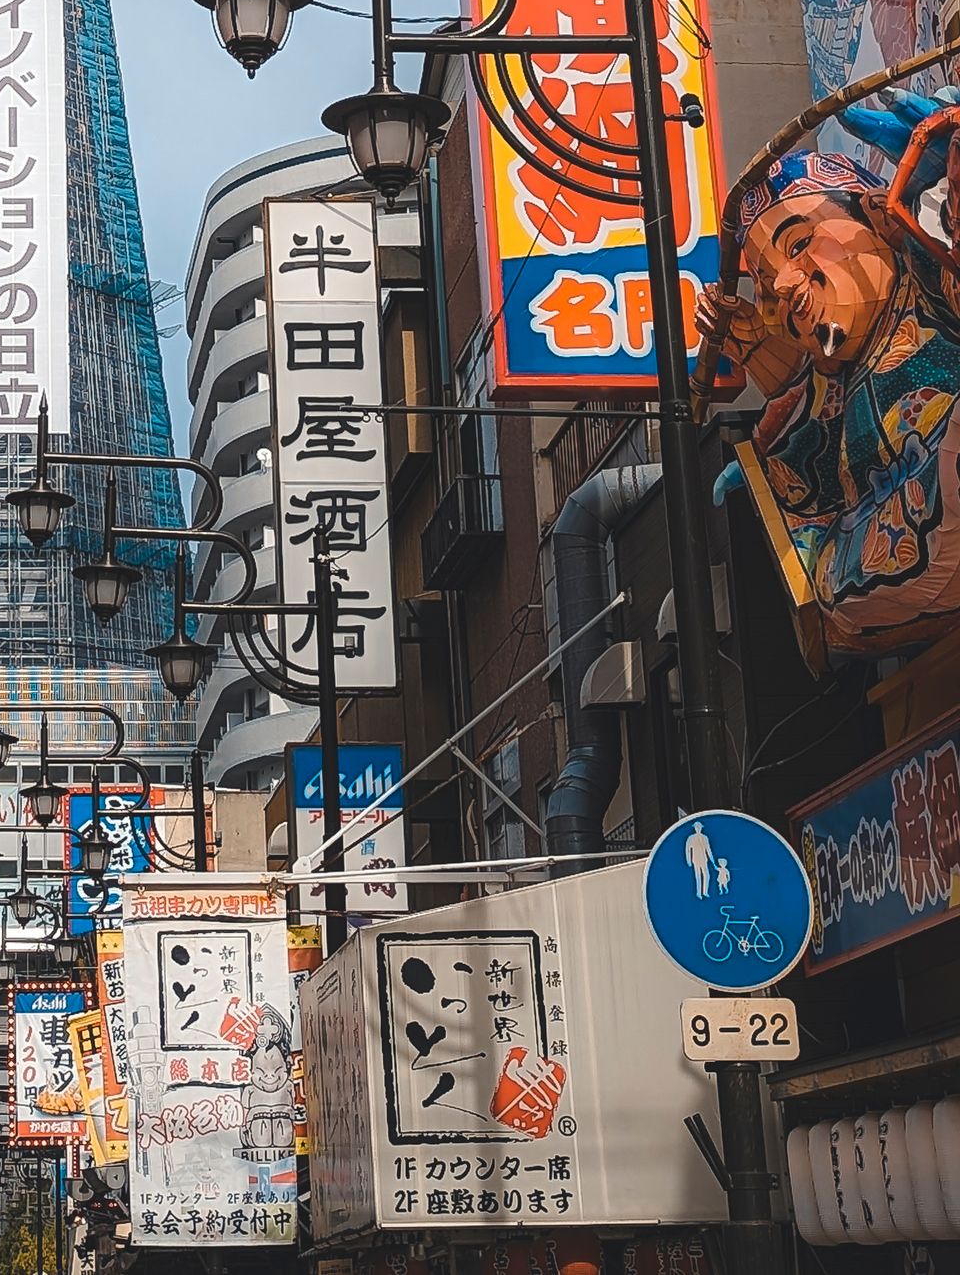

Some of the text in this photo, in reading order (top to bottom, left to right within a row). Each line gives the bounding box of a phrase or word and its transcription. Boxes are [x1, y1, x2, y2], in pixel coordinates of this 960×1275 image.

[278, 225, 386, 661] 半田屋酒店
[309, 810, 391, 825] アヒビール
[131, 895, 278, 916] 元祖串カツ専門店
[218, 945, 242, 995] 新世界
[32, 996, 67, 1010] Asahi
[485, 959, 525, 1043] 新世界
[543, 936, 569, 1057] 商標登録
[138, 1094, 246, 1150] 大阪名物
[394, 1155, 571, 1181] 1F カウンター席
[395, 1189, 573, 1215] 2F 座敷あります
[140, 1209, 292, 1236] 宴会予約受付中
